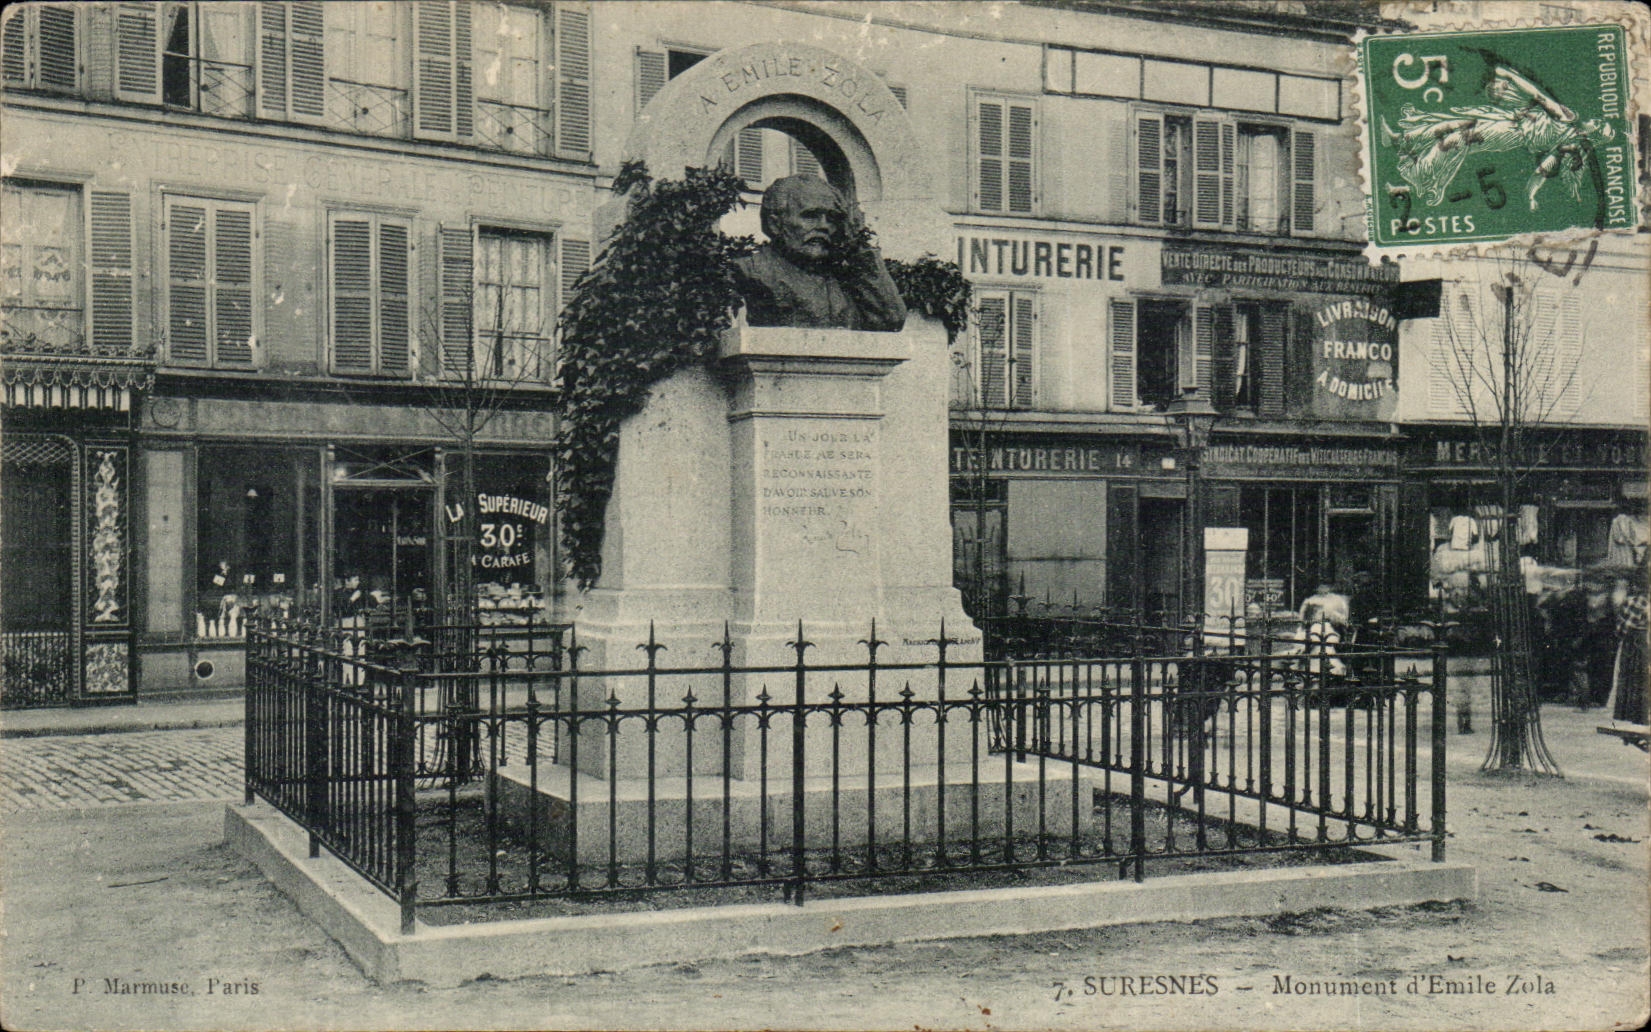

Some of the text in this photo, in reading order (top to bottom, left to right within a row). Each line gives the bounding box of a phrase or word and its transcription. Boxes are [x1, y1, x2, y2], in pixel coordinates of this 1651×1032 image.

[699, 95, 718, 114] A
[820, 65, 886, 126] ZOLA
[1604, 146, 1626, 225] FRANÇAISE
[1390, 214, 1476, 236] POSTES
[957, 236, 1125, 282] INTURERIE
[1161, 251, 1191, 269] VENTE
[1192, 252, 1233, 271] DIRECTE
[1248, 254, 1316, 278] PRODUCTEURS
[1182, 271, 1212, 284] AVEC
[1222, 272, 1308, 292] PARTICIPATION
[1311, 280, 1332, 292] AUX
[1316, 301, 1397, 332] LIVRAISON
[1323, 340, 1392, 361] FRANCO
[854, 433, 872, 443] LA
[1202, 444, 1246, 463] SYNDICAT
[763, 469, 873, 480] RECONNAISSANTE
[477, 493, 549, 525] SUPÉRIEUR
[481, 552, 531, 569] CARAFE
